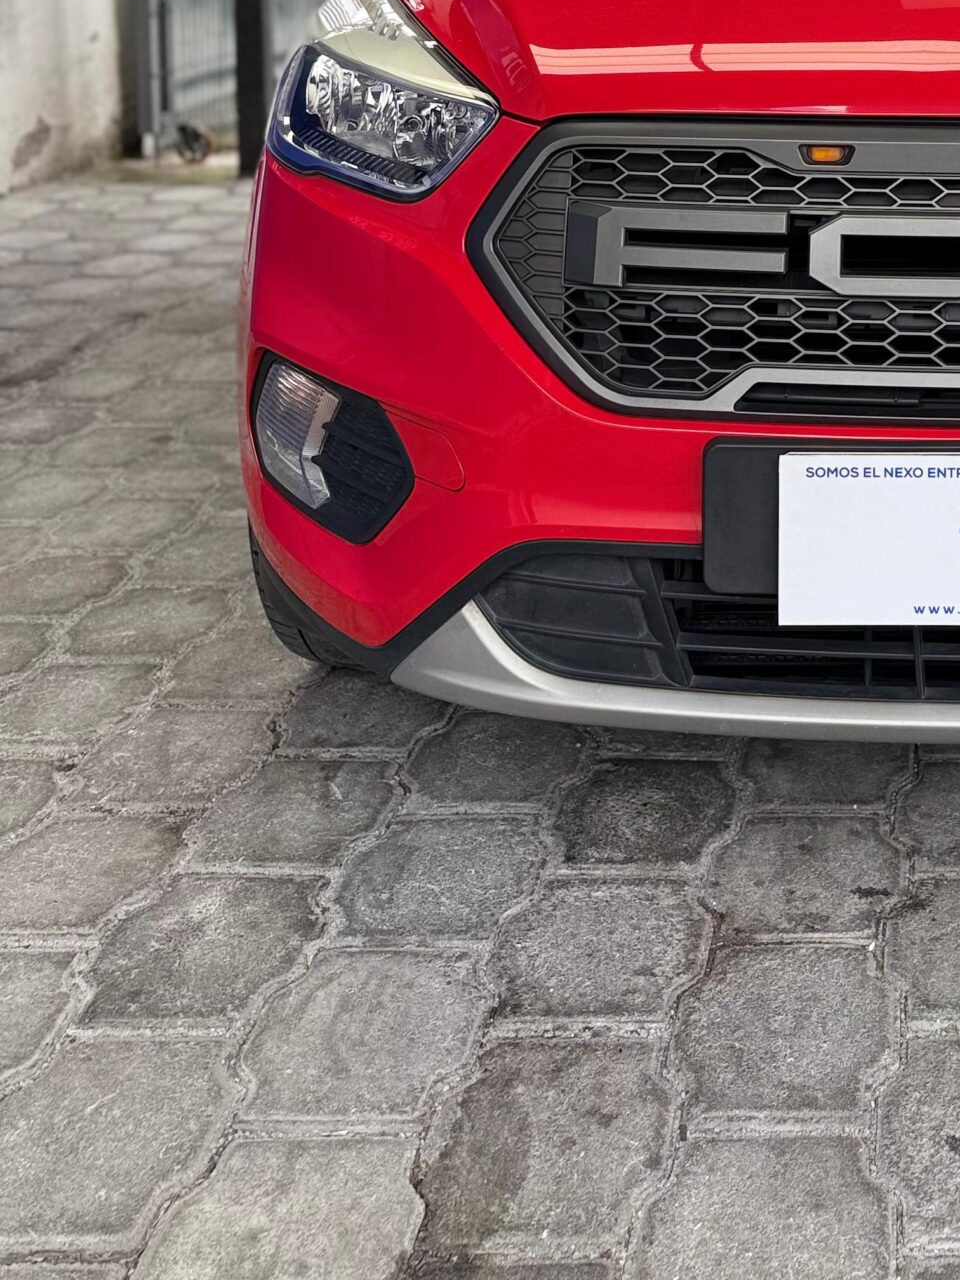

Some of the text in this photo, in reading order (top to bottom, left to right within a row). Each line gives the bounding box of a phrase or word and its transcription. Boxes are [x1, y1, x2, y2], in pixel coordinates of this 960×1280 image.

[805, 466, 860, 478] SOMOS
[863, 466, 881, 478] EL
[883, 466, 924, 478] NEXO
